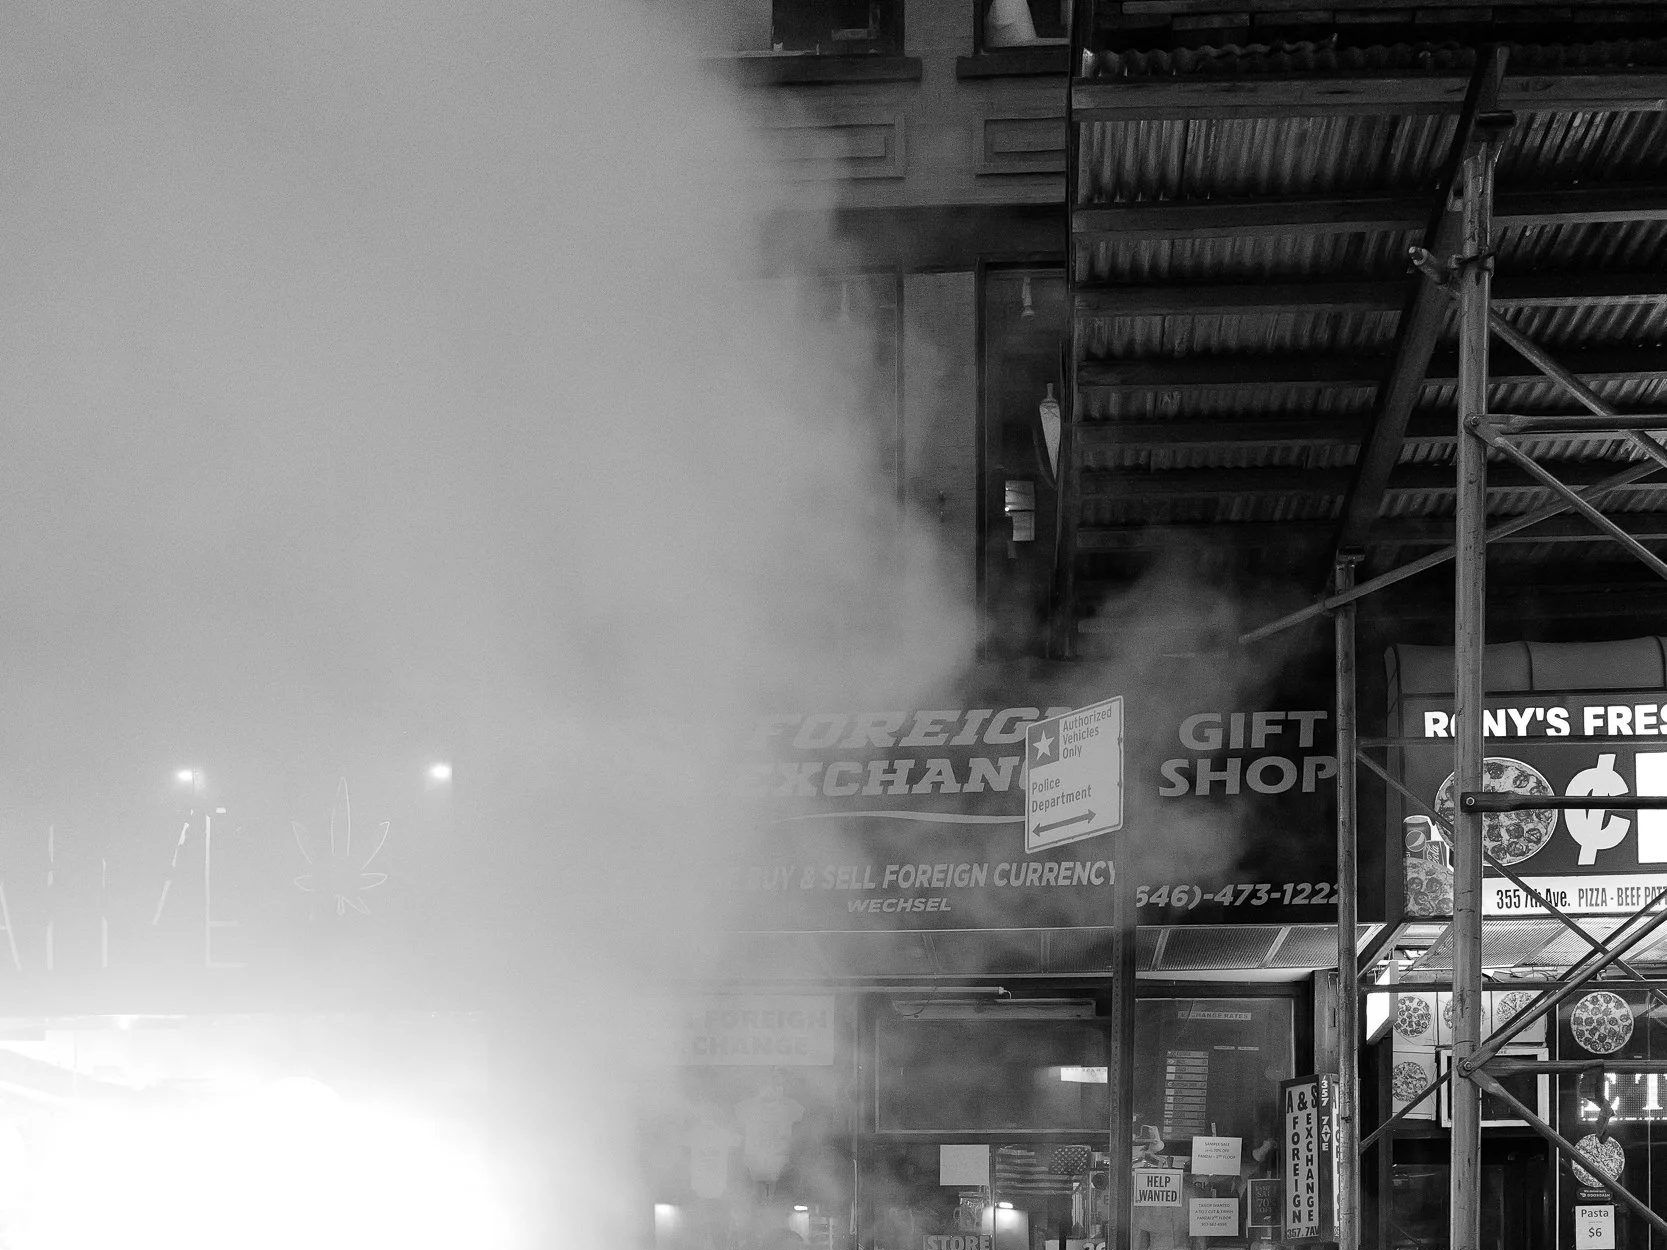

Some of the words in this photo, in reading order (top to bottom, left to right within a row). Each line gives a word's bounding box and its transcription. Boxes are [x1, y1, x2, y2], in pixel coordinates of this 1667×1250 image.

[742, 706, 1071, 749] FOREIG
[1063, 705, 1112, 731] Authorized
[1179, 710, 1327, 750] GIFT
[1424, 706, 1571, 738] RNY'S
[1583, 704, 1667, 736] FRE
[1063, 726, 1099, 745] Vehicles
[1062, 744, 1082, 759] Only
[734, 757, 1027, 797] EXCHAN
[1032, 777, 1060, 795] Police
[1159, 755, 1337, 797] SHOP
[1031, 784, 1091, 813] Department
[800, 864, 817, 888] &
[820, 863, 876, 889] SELL
[882, 862, 992, 889] FOREIGN
[848, 898, 951, 913] WECHSEL
[1495, 888, 1521, 910] 355
[1545, 887, 1571, 908] Ave.
[1578, 887, 1608, 908] PIZZA
[1616, 885, 1642, 907] BEEF
[1287, 1090, 1294, 1113] A
[1297, 1091, 1308, 1111] &
[1292, 1115, 1301, 1223] FOREIGN
[1305, 1112, 1315, 1221] EXCHANGE
[1147, 1175, 1171, 1188] HELP
[1139, 1189, 1177, 1202] WANTED
[1581, 1208, 1609, 1218] Pasta
[1588, 1226, 1603, 1239] $6
